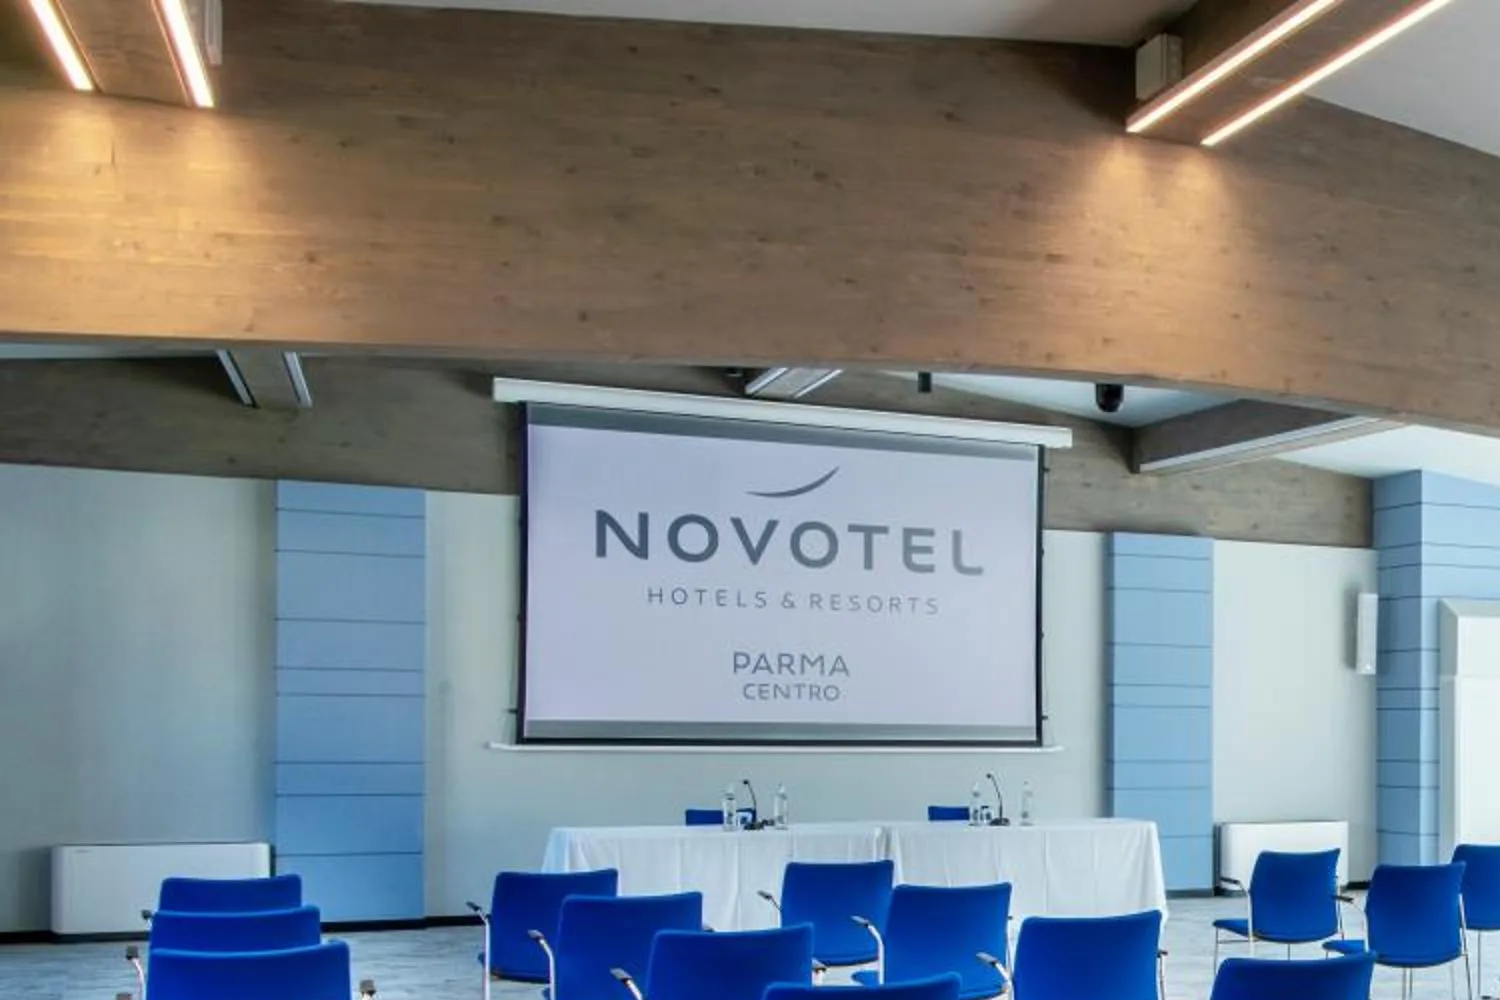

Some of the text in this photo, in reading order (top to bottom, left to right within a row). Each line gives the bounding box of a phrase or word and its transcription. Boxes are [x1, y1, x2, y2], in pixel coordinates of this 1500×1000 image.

[595, 509, 984, 576] NOVOTEL
[648, 586, 939, 615] HOTELS & RESORTS
[733, 651, 850, 677] PARMA
[743, 682, 840, 701] CENTRO
